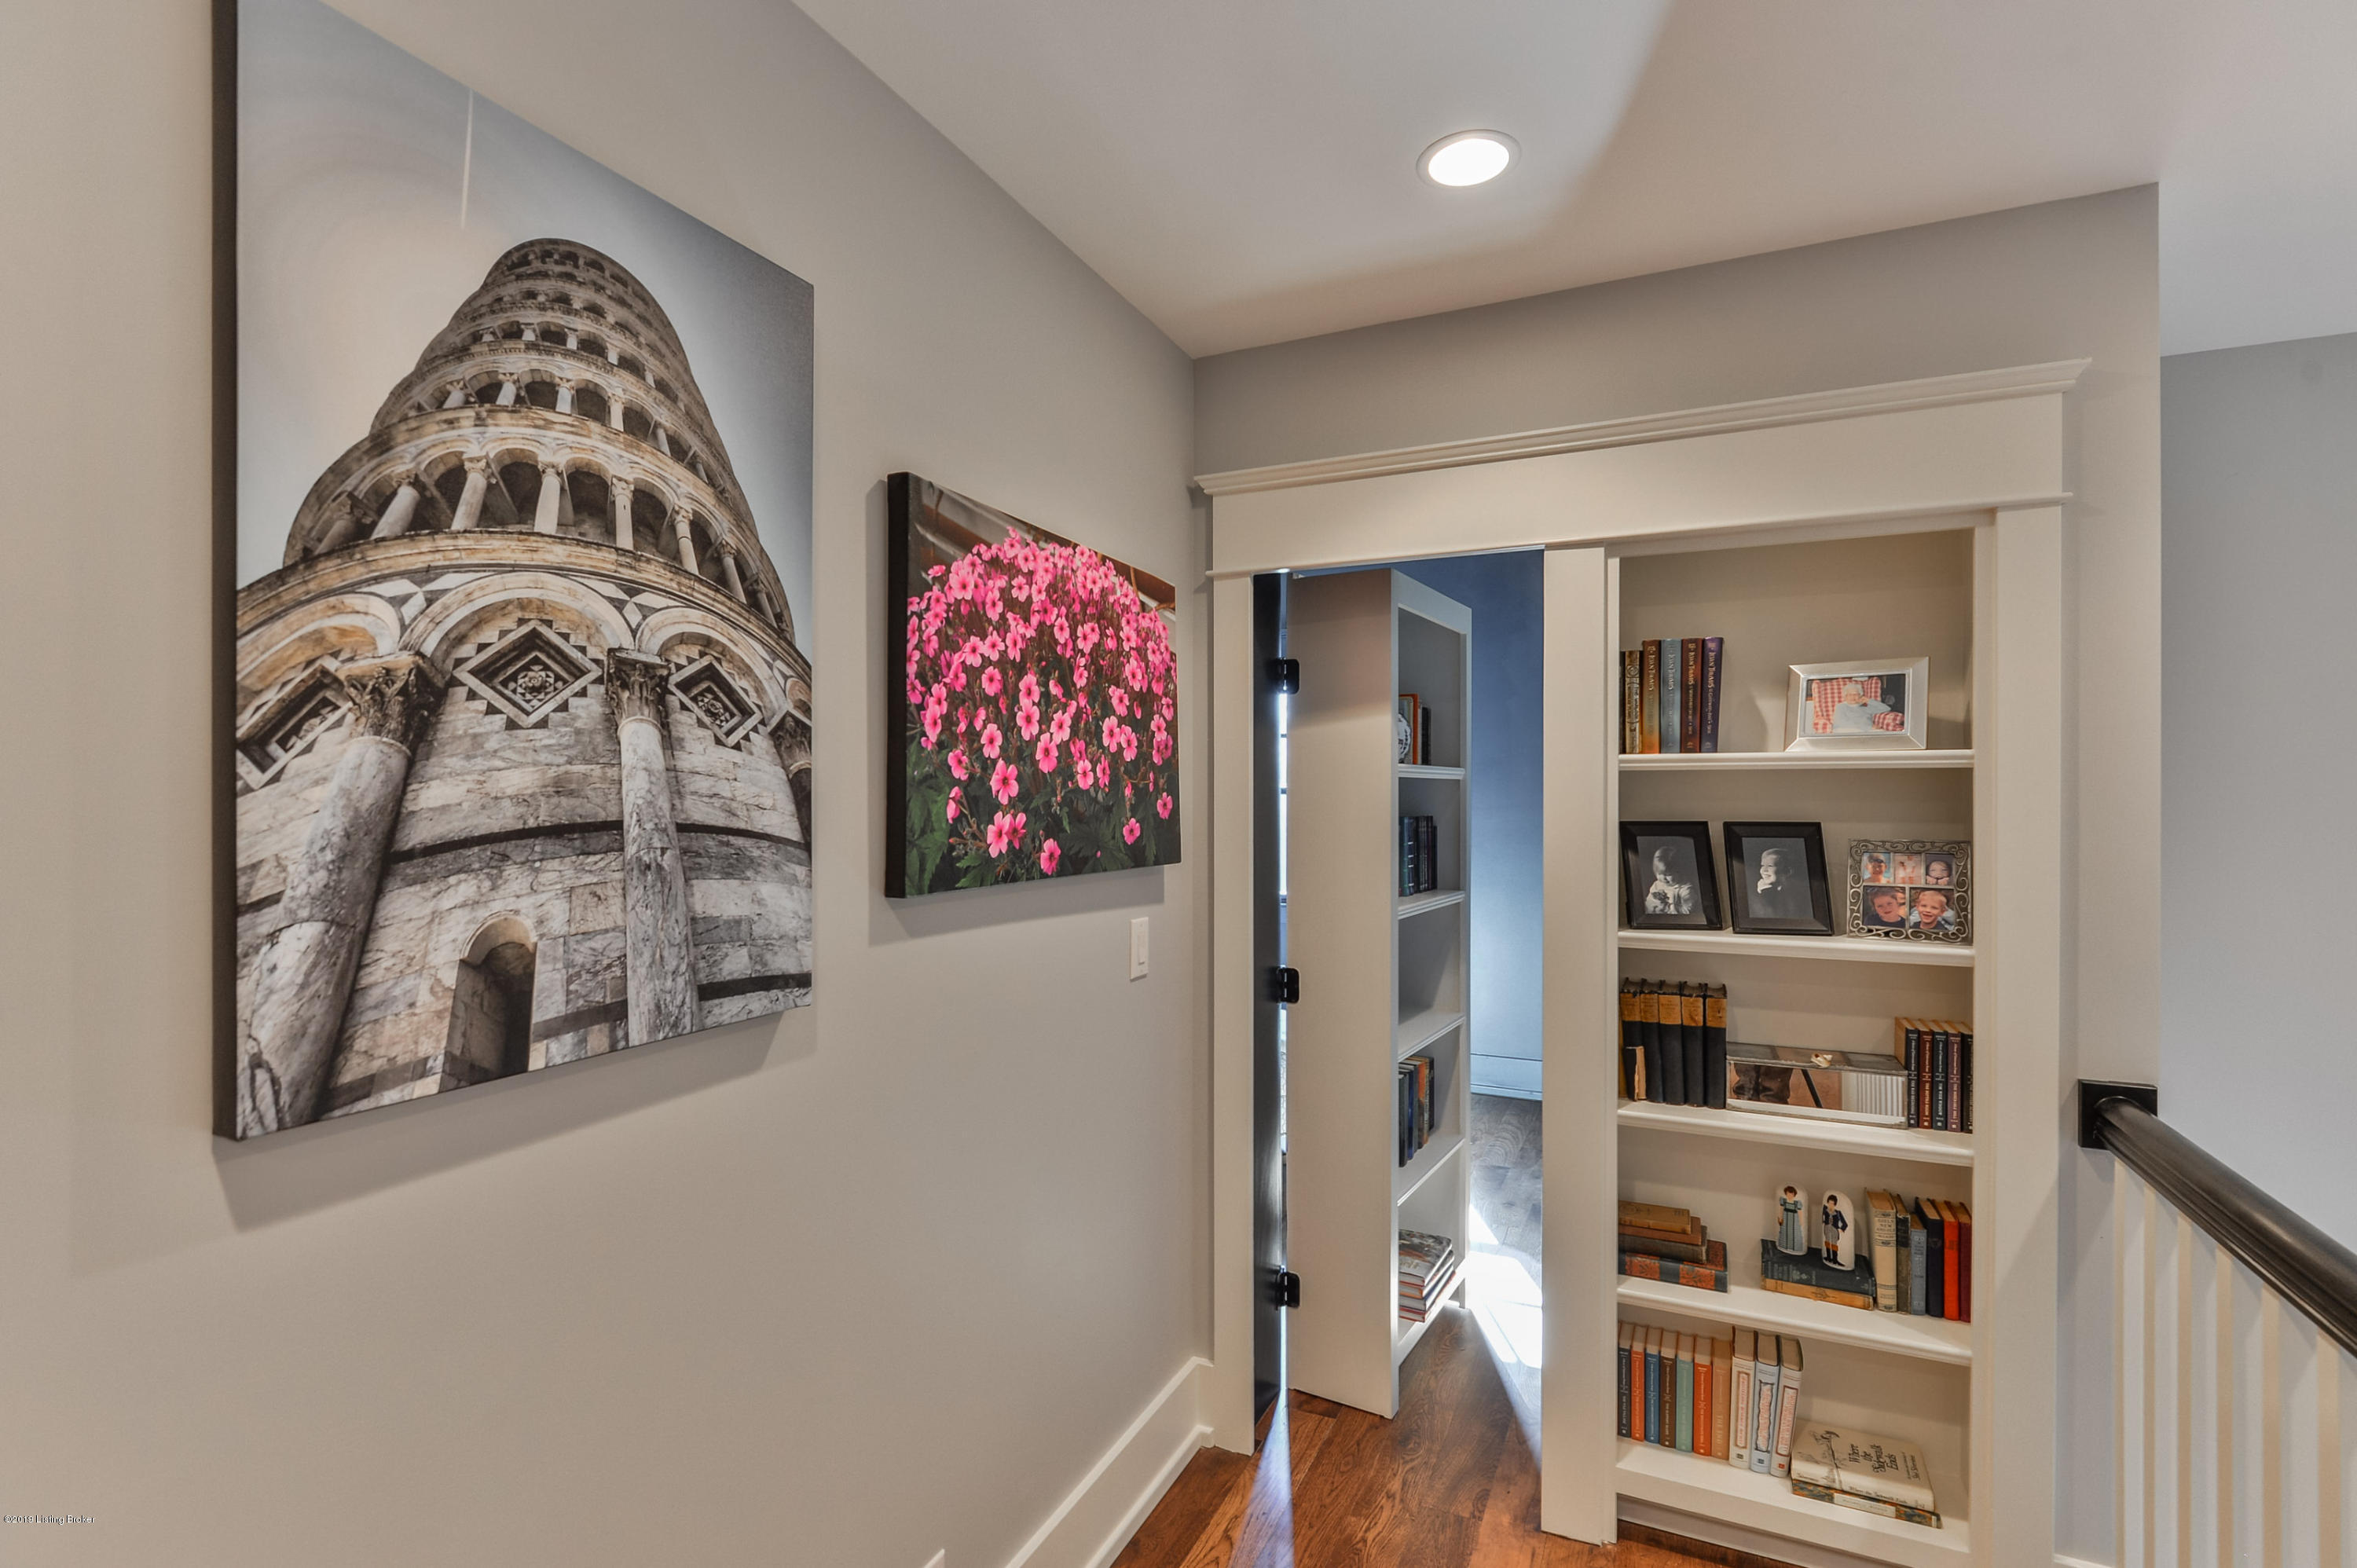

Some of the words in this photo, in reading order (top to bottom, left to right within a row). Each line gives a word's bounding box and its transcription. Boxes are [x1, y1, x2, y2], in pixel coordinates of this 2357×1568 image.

[1849, 1444, 1860, 1464] Where
[1860, 1451, 1873, 1462] the
[1886, 1453, 1899, 1471] Ends
